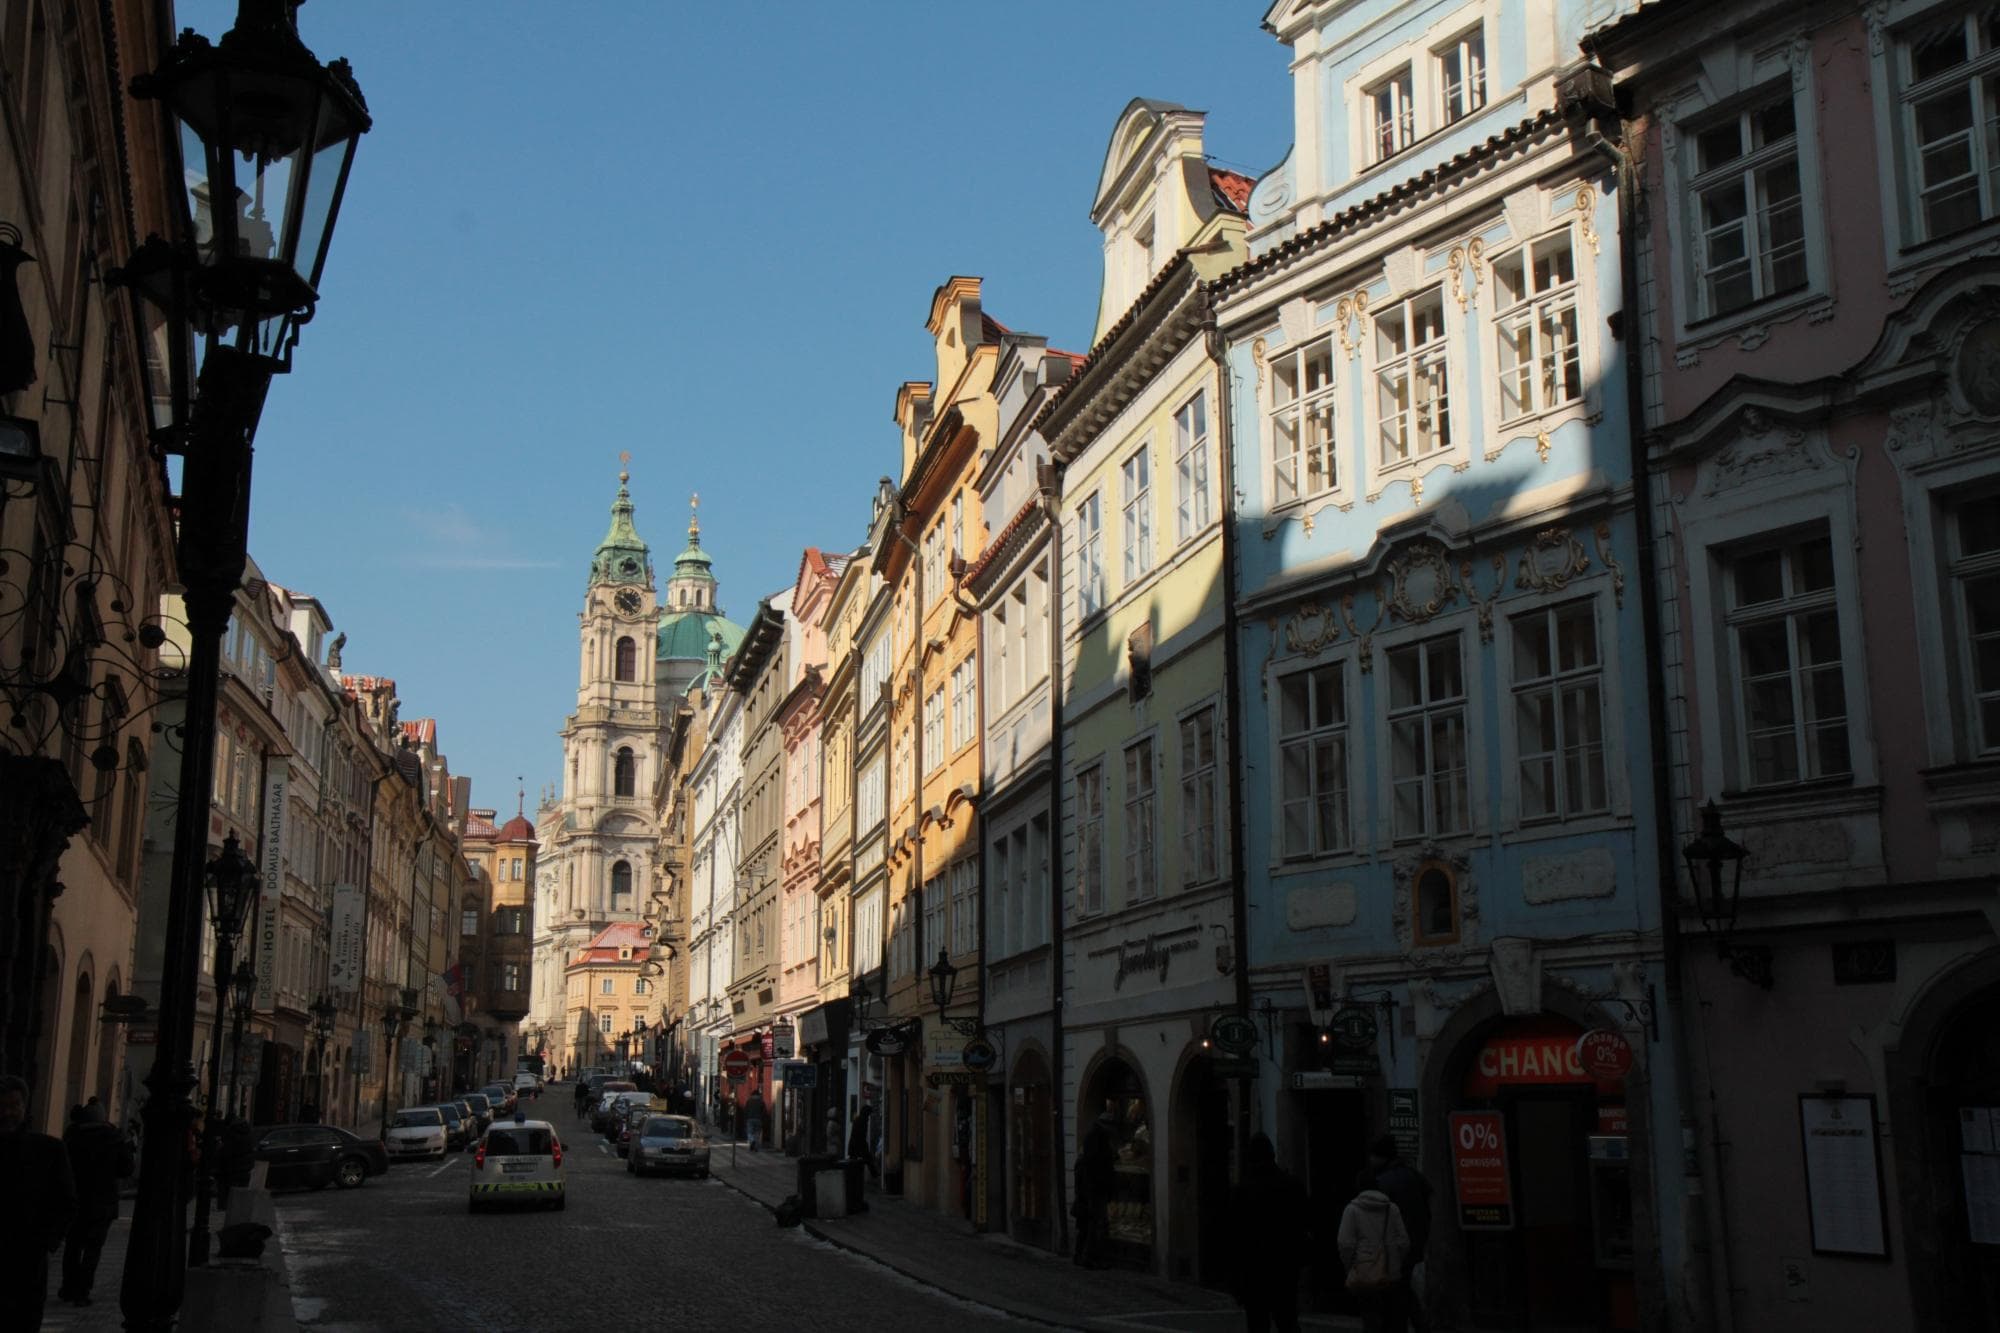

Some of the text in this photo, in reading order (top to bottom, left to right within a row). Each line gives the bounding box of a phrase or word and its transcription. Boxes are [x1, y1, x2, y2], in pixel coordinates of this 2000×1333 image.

[259, 783, 283, 1000] DESIGN HOTEL DOMUS BALTHASAR
[1596, 1046, 1617, 1063] 0%
[1459, 1122, 1498, 1150] 0%
